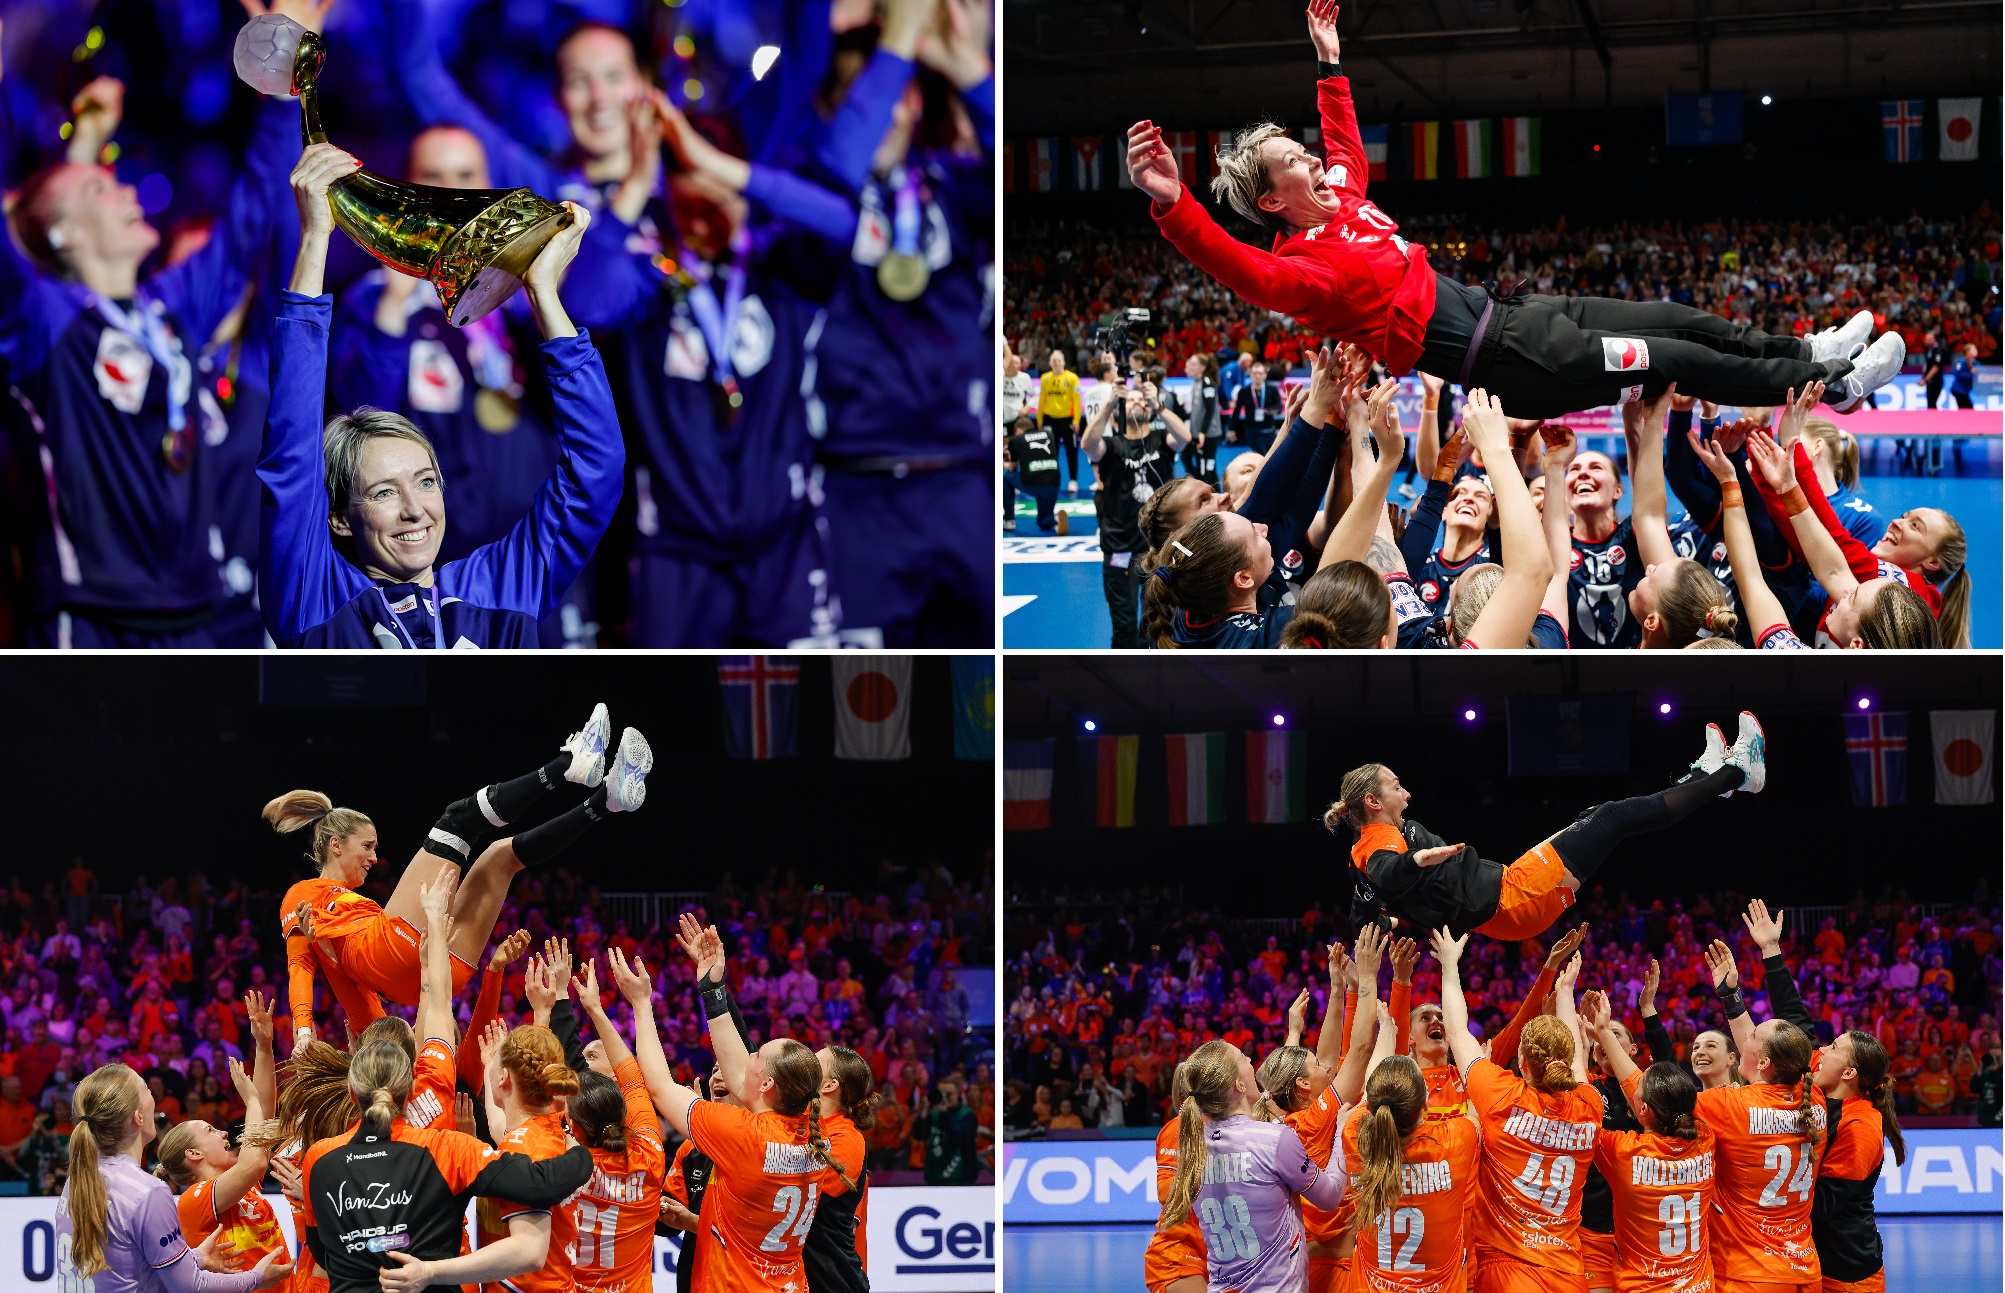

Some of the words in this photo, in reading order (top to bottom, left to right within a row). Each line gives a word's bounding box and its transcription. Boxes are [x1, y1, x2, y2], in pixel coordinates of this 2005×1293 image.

[1584, 555, 1612, 585] 15
[1503, 1106, 1597, 1150] HOUSHEER
[326, 1180, 413, 1217] VanZus
[1512, 1152, 1576, 1216] 48
[1632, 1150, 1714, 1187] VOLLEBREGT
[1758, 1142, 1814, 1207] 24
[760, 1183, 818, 1252] 24
[1201, 1195, 1261, 1262] 38
[1375, 1207, 1426, 1271] 12
[1658, 1191, 1701, 1257] 31
